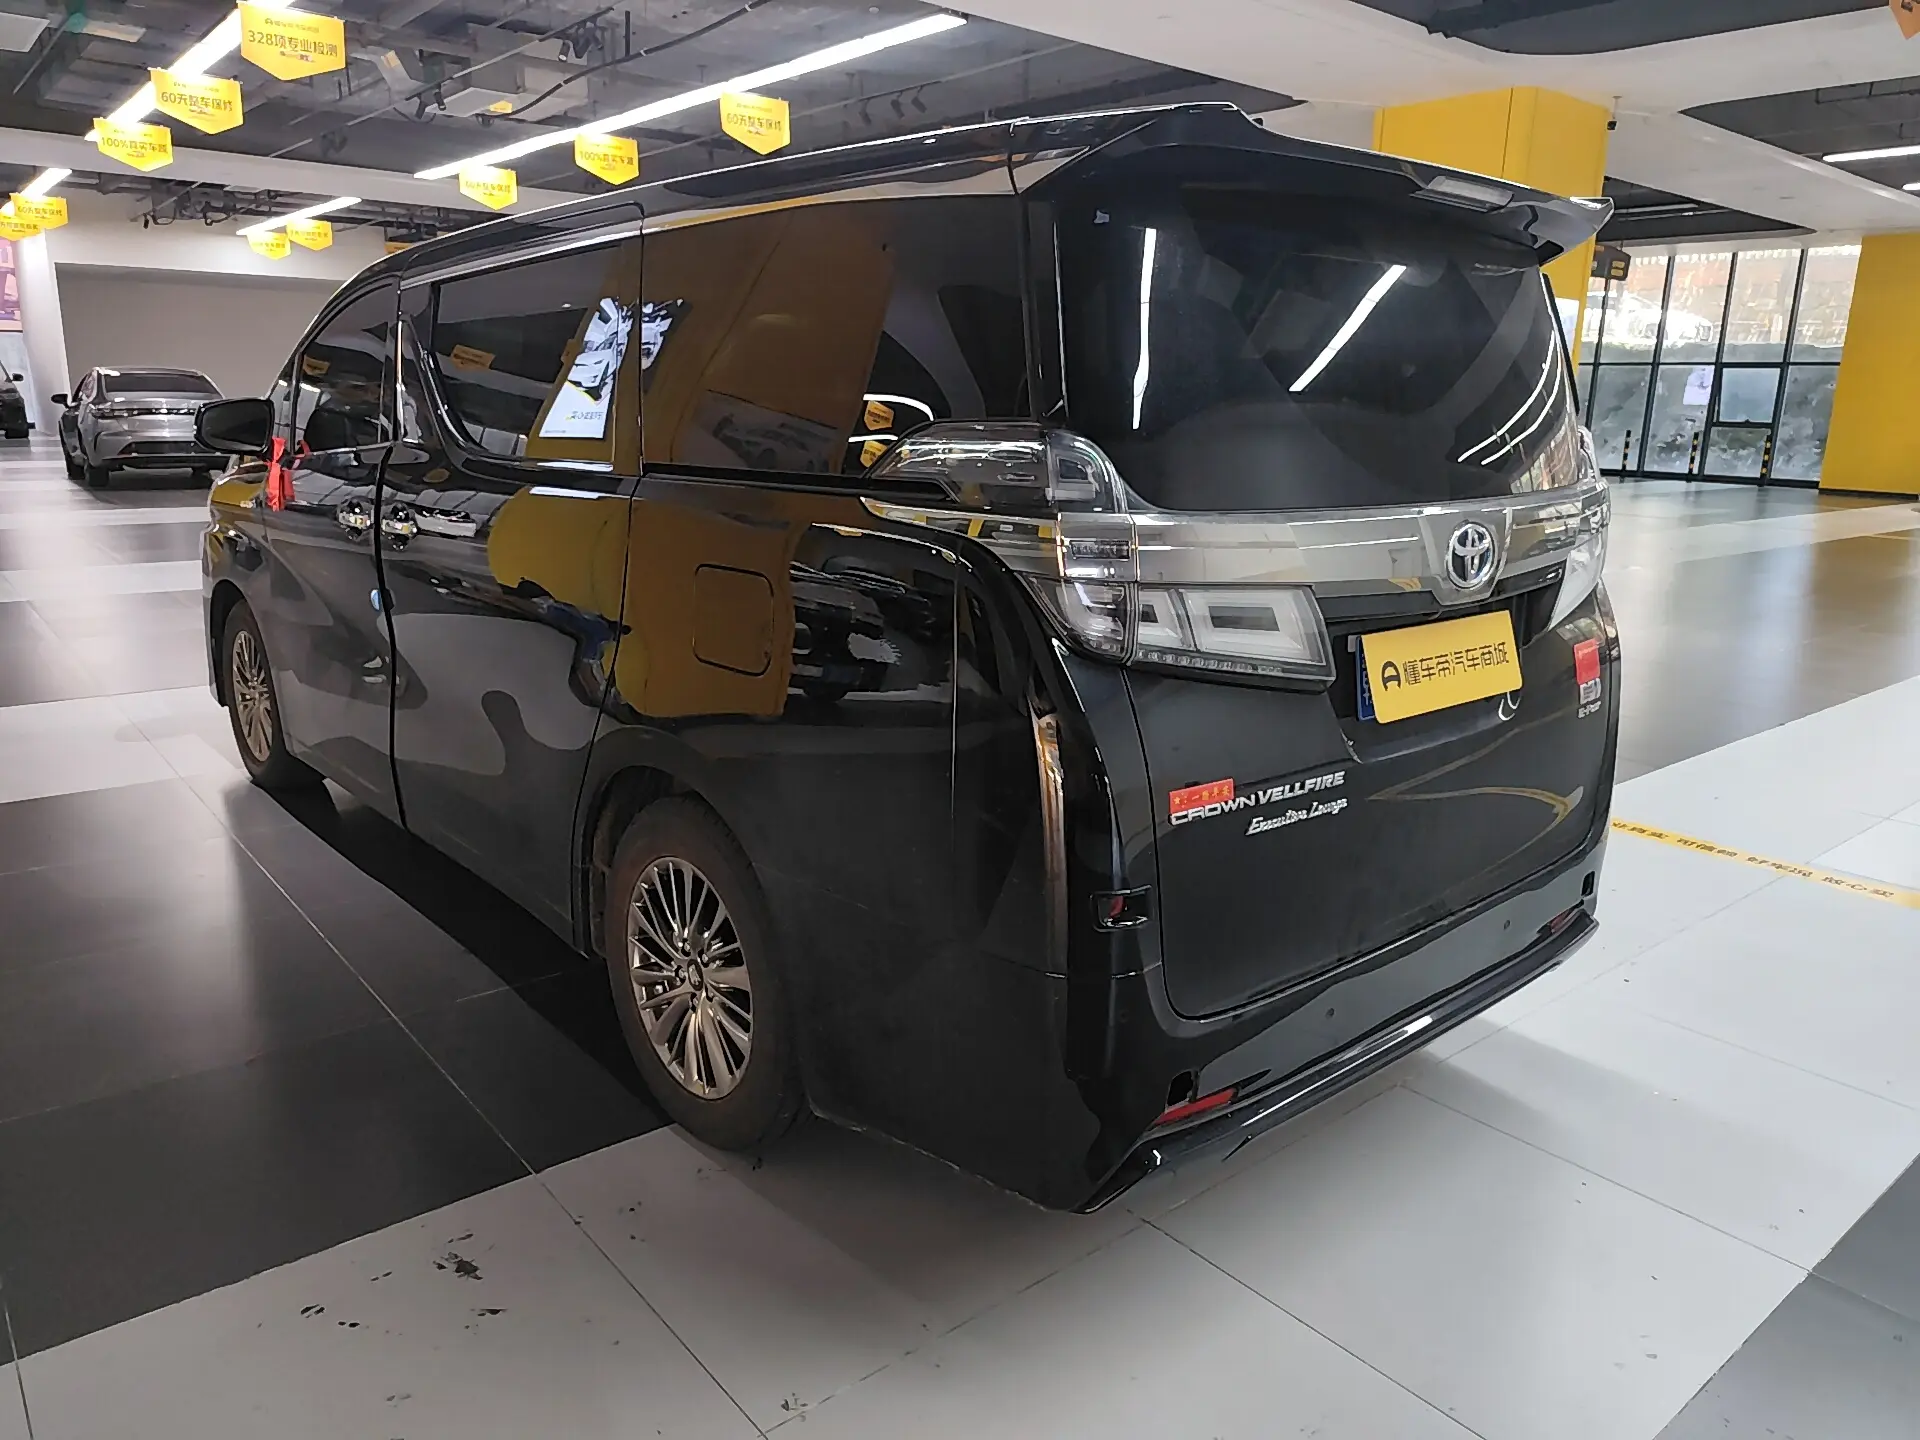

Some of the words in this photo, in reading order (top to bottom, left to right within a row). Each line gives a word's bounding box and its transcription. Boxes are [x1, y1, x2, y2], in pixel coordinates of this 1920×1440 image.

[247, 29, 338, 57] 328项专业检测
[161, 91, 233, 112] 60天整车保修
[1402, 641, 1510, 686] 懂车帝汽车商城
[1171, 794, 1256, 826] CROWN
[1257, 770, 1346, 804] VELLFIRE
[1245, 808, 1308, 836] Executive
[1308, 798, 1348, 818] Lounge
